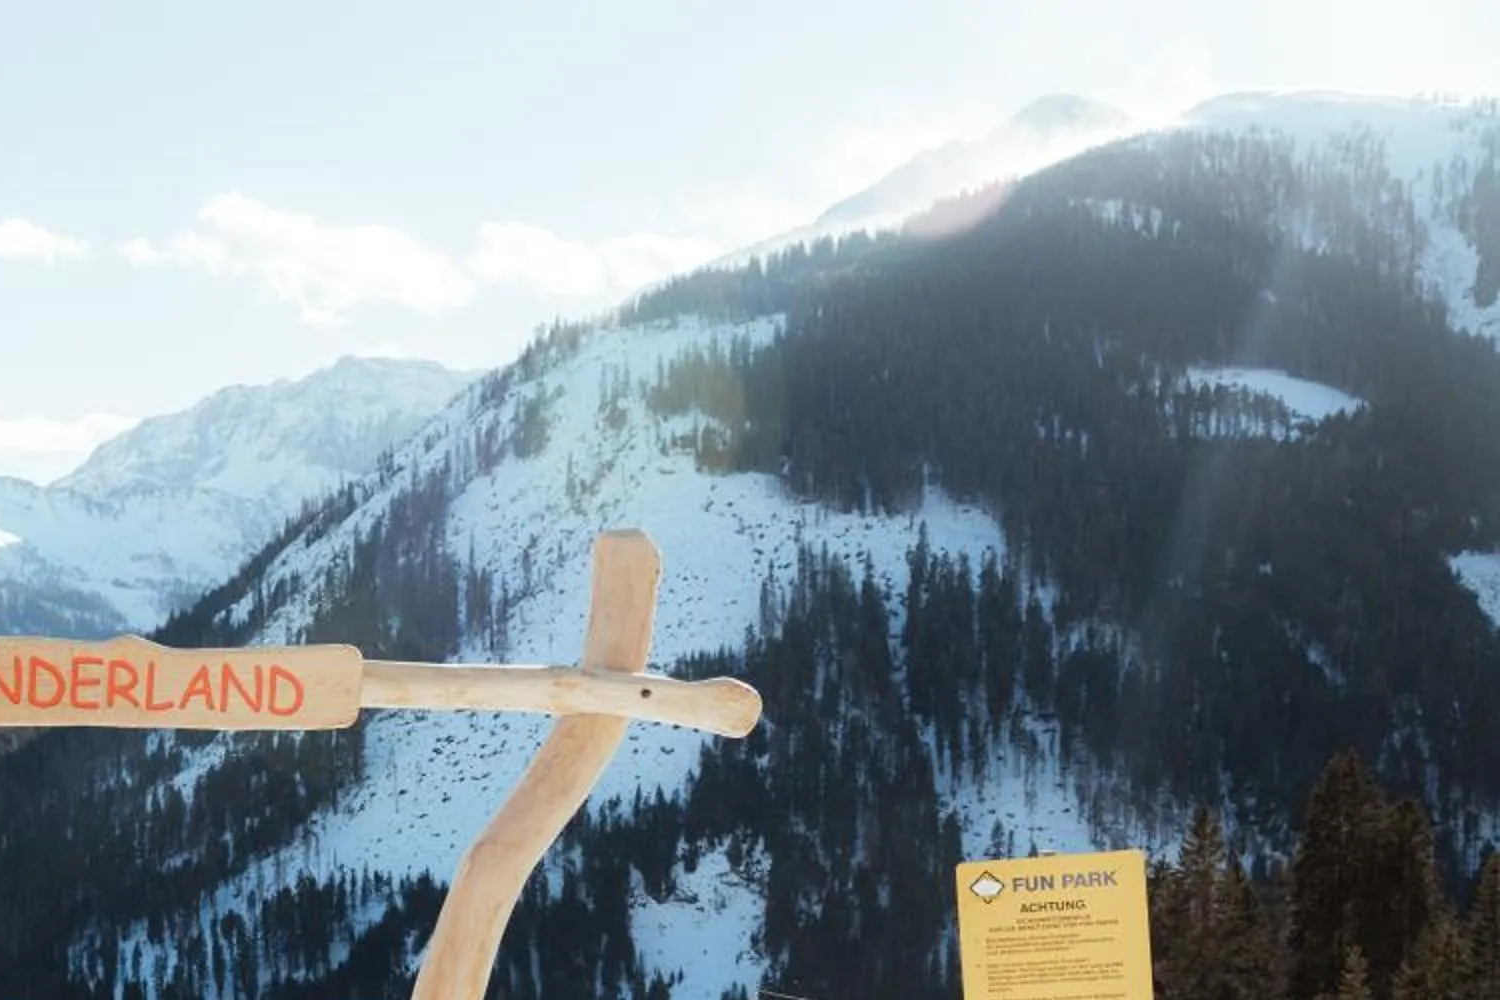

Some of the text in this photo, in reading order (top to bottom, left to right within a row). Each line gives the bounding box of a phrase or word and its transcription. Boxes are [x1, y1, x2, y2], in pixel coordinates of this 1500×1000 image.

[1012, 871, 1118, 892] FUN PARK
[1020, 900, 1086, 913] ACHTUNG
